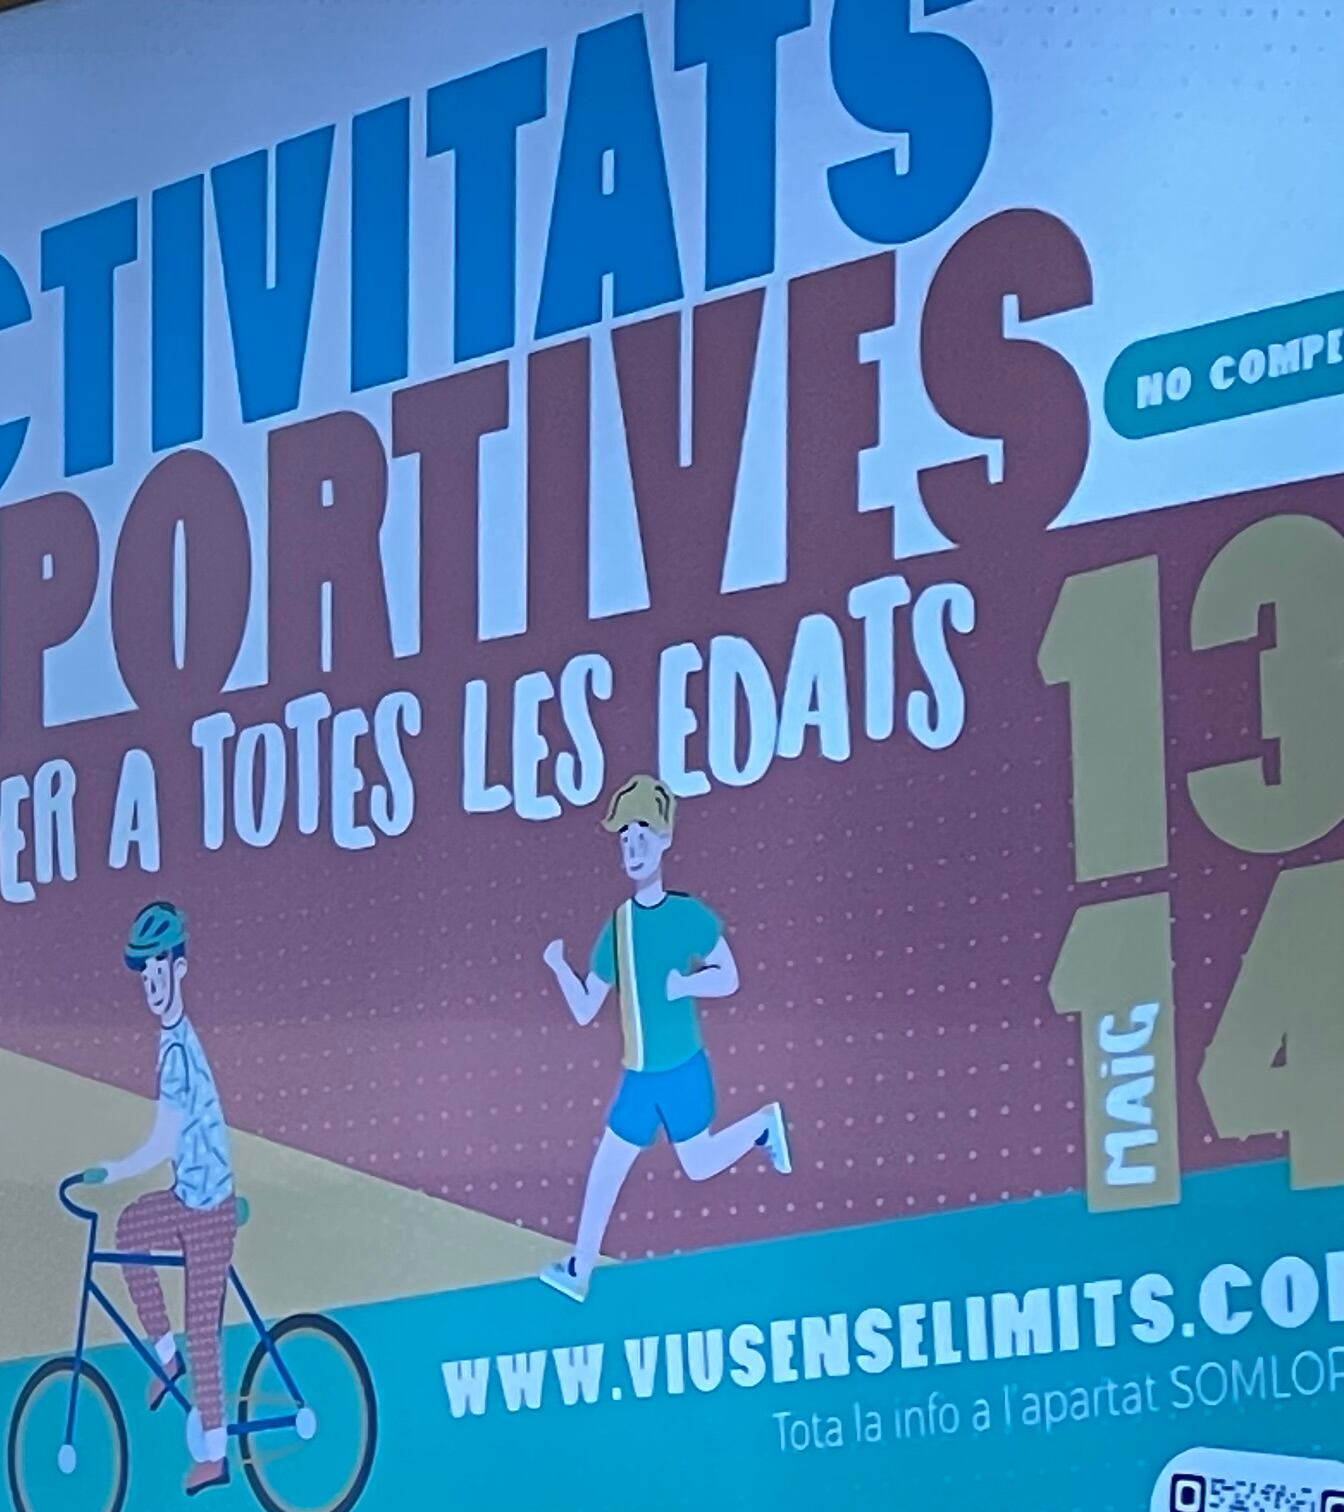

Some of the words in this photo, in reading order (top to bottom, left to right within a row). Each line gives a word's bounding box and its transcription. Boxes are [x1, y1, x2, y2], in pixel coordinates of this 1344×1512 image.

[1137, 366, 1192, 409] NO
[109, 748, 160, 873] A
[192, 689, 424, 851] TOTES
[462, 652, 614, 821] LES
[657, 574, 977, 798] EDATS
[1037, 514, 1344, 882] 13
[1047, 860, 1344, 1213] 14
[772, 1411, 844, 1452] Tota
[854, 1402, 882, 1443] la
[894, 1389, 960, 1438] info
[971, 1397, 991, 1432] a
